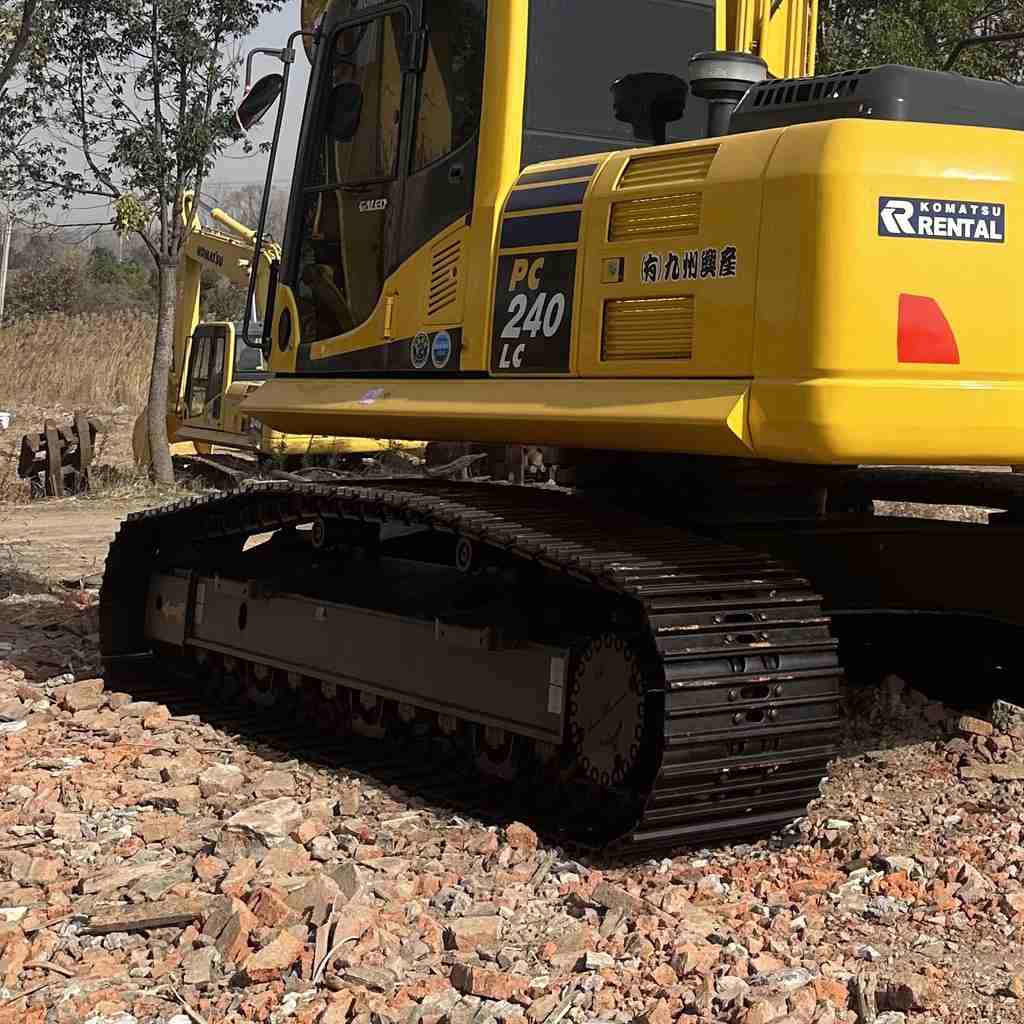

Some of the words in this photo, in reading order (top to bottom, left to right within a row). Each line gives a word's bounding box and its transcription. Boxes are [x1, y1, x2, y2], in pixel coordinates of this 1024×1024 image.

[920, 202, 1001, 216] KOMATSU
[918, 216, 1003, 239] RENTAL
[508, 257, 545, 292] PC
[500, 292, 565, 339] 240
[499, 343, 526, 368] LC
